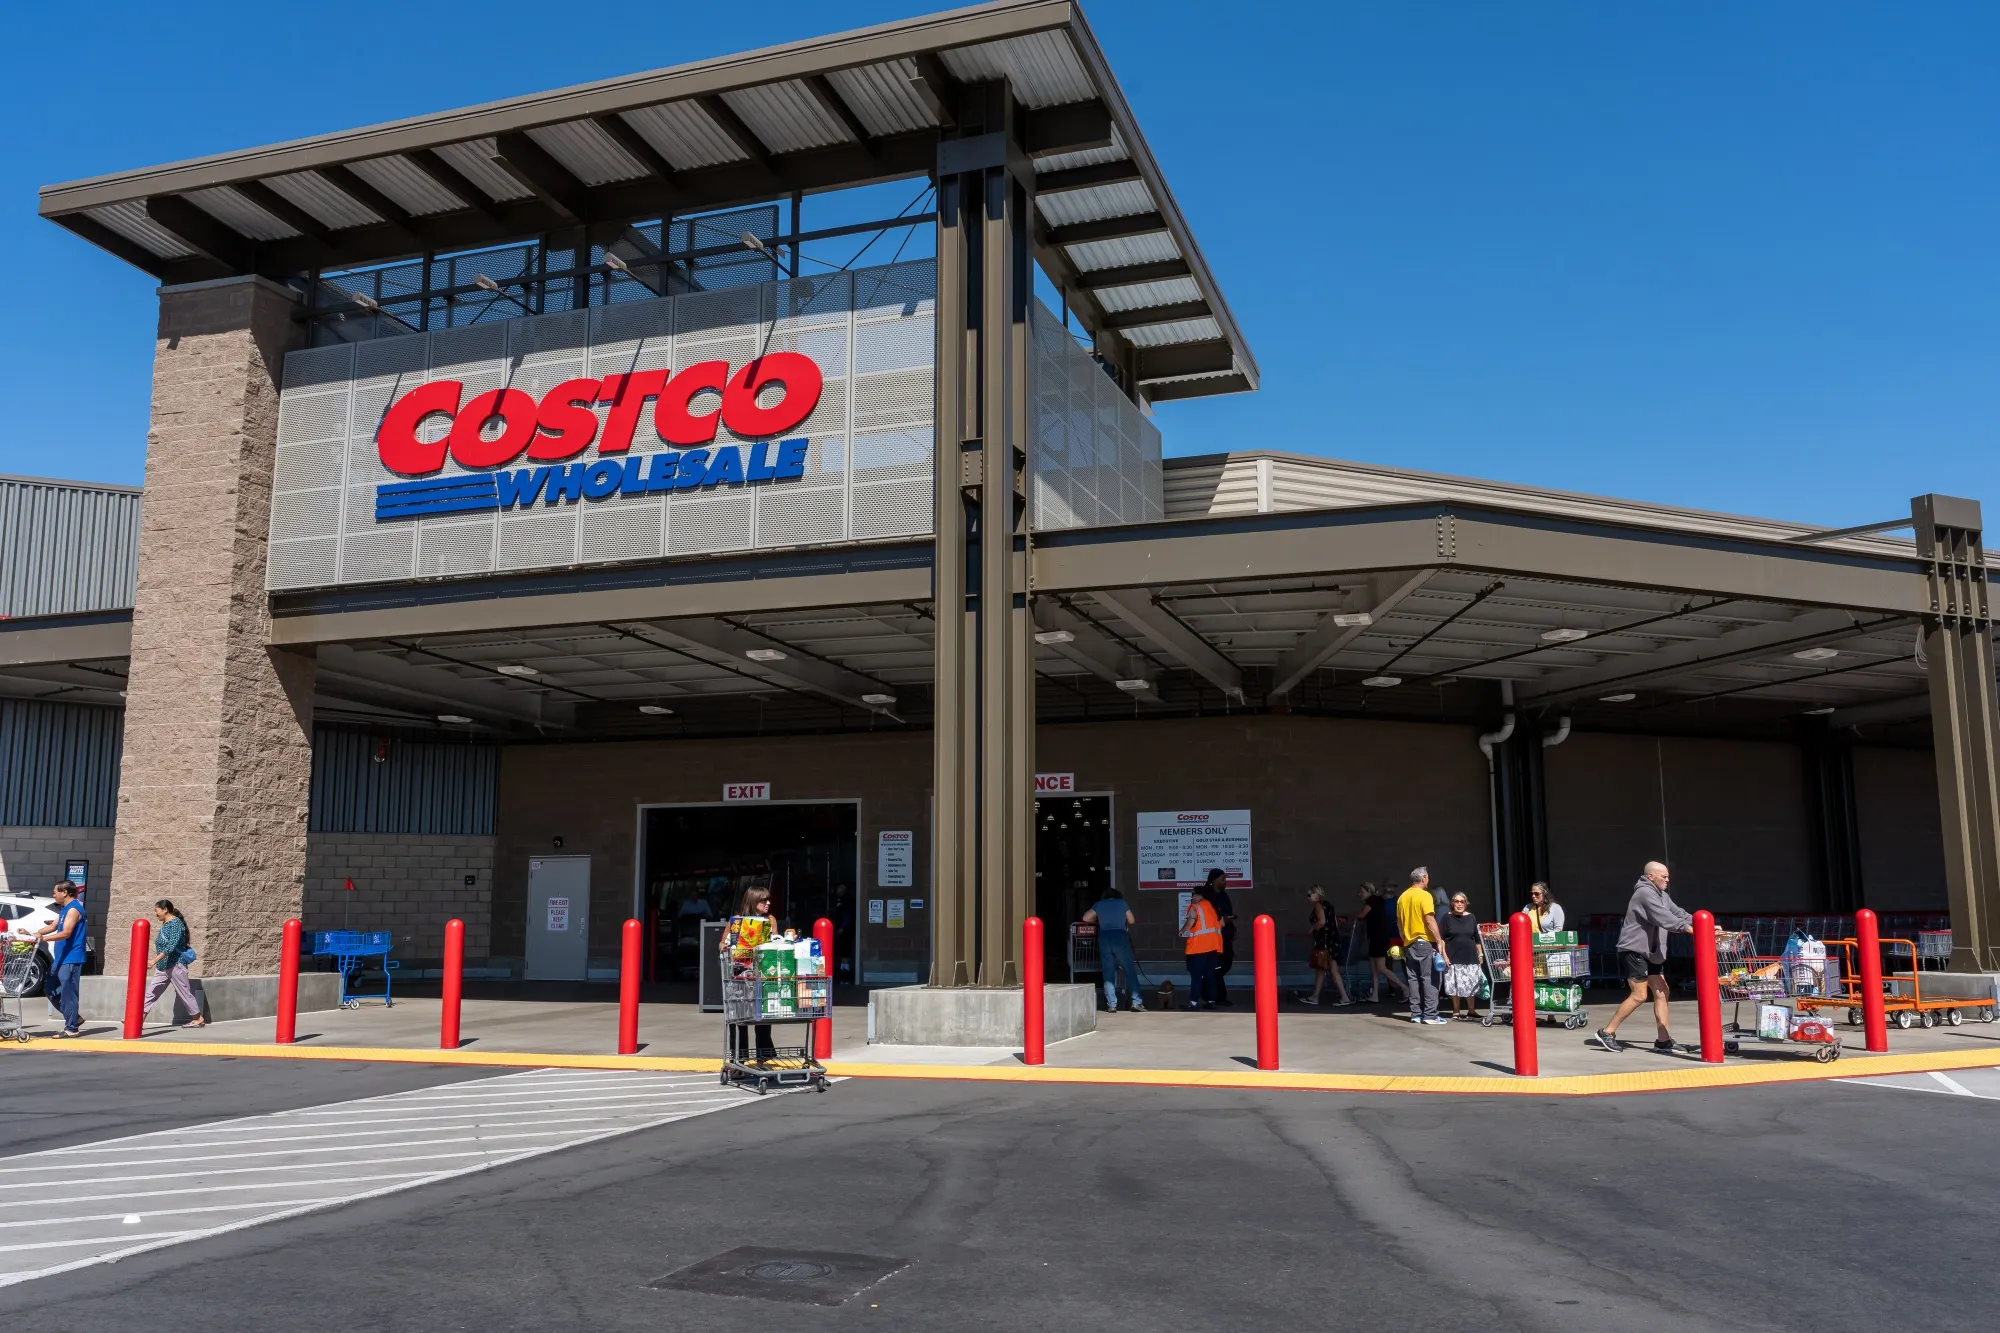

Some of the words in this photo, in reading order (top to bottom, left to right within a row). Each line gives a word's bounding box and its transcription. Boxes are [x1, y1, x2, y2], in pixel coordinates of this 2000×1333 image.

[377, 351, 823, 475] COSTCO
[496, 437, 808, 507] WHOLESALE
[728, 786, 765, 798] EXIT
[1160, 828, 1203, 836] MEMBERS
[1205, 827, 1228, 835] ONLY
